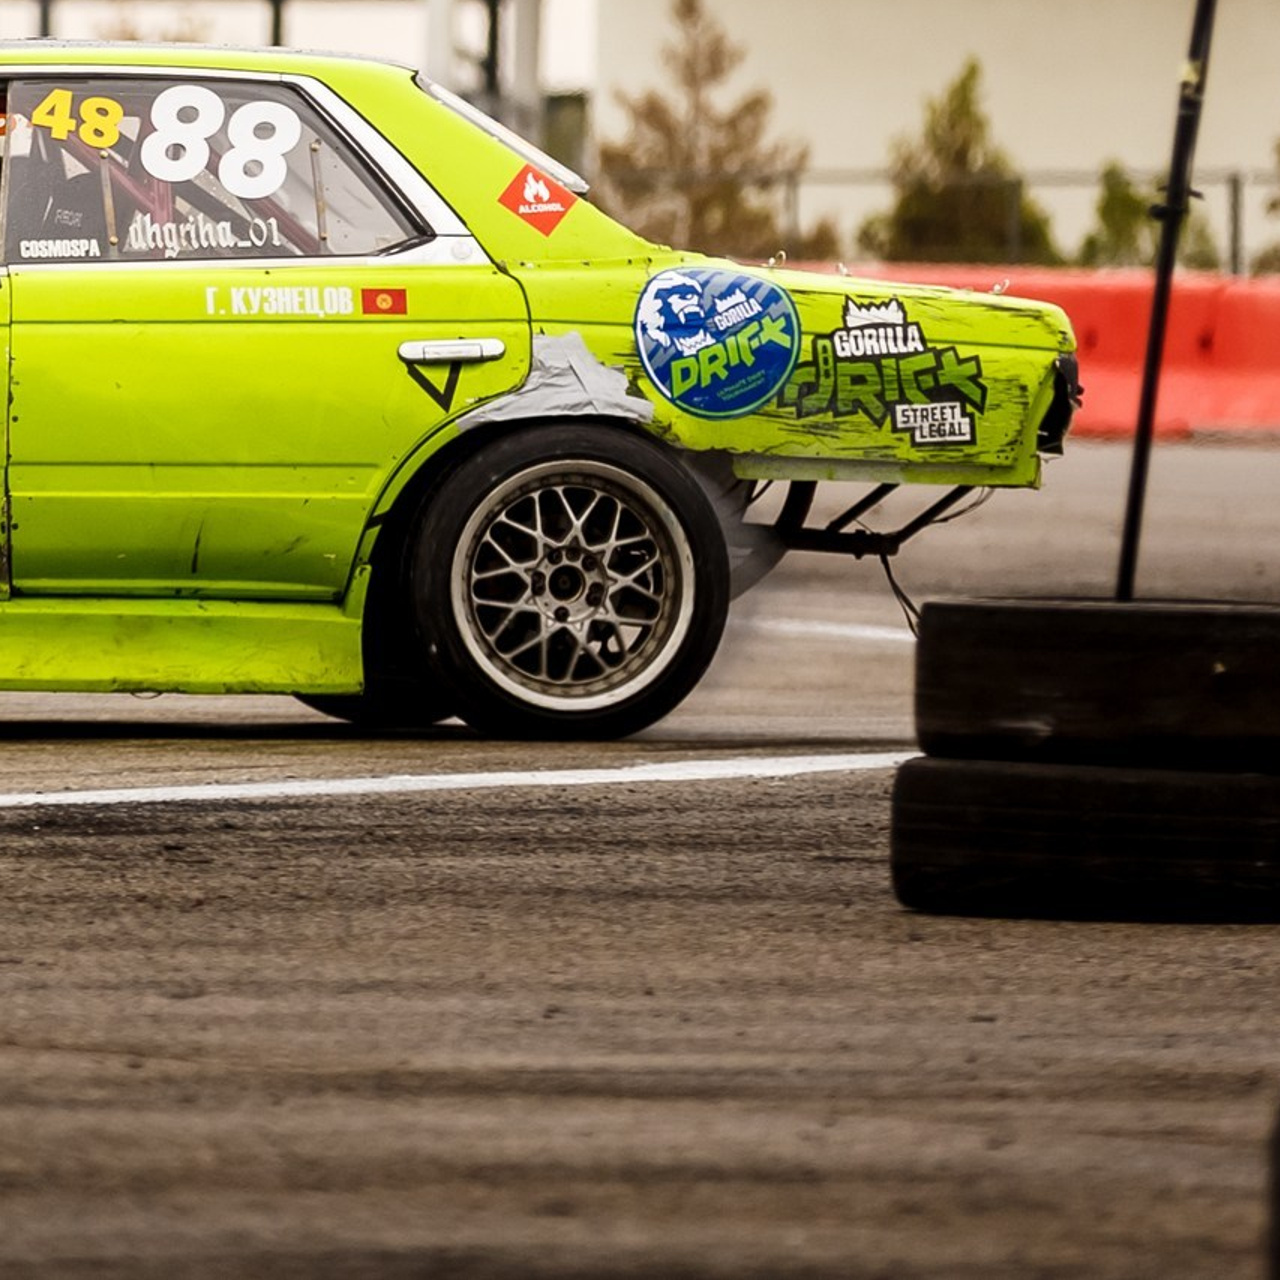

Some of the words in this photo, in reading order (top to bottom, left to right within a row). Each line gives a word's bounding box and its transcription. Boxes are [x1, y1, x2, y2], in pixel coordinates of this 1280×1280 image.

[31, 88, 124, 149] 48
[140, 84, 302, 199] 88
[20, 239, 101, 258] COSMOSPA
[205, 287, 226, 315] Г.
[230, 286, 354, 318] КУЗНЕЦОВ
[713, 297, 763, 331] GORILLA
[671, 315, 792, 398] DRIFT
[833, 324, 924, 358] GORILLA
[901, 405, 958, 424] STREET
[920, 421, 967, 439] LEGAL
